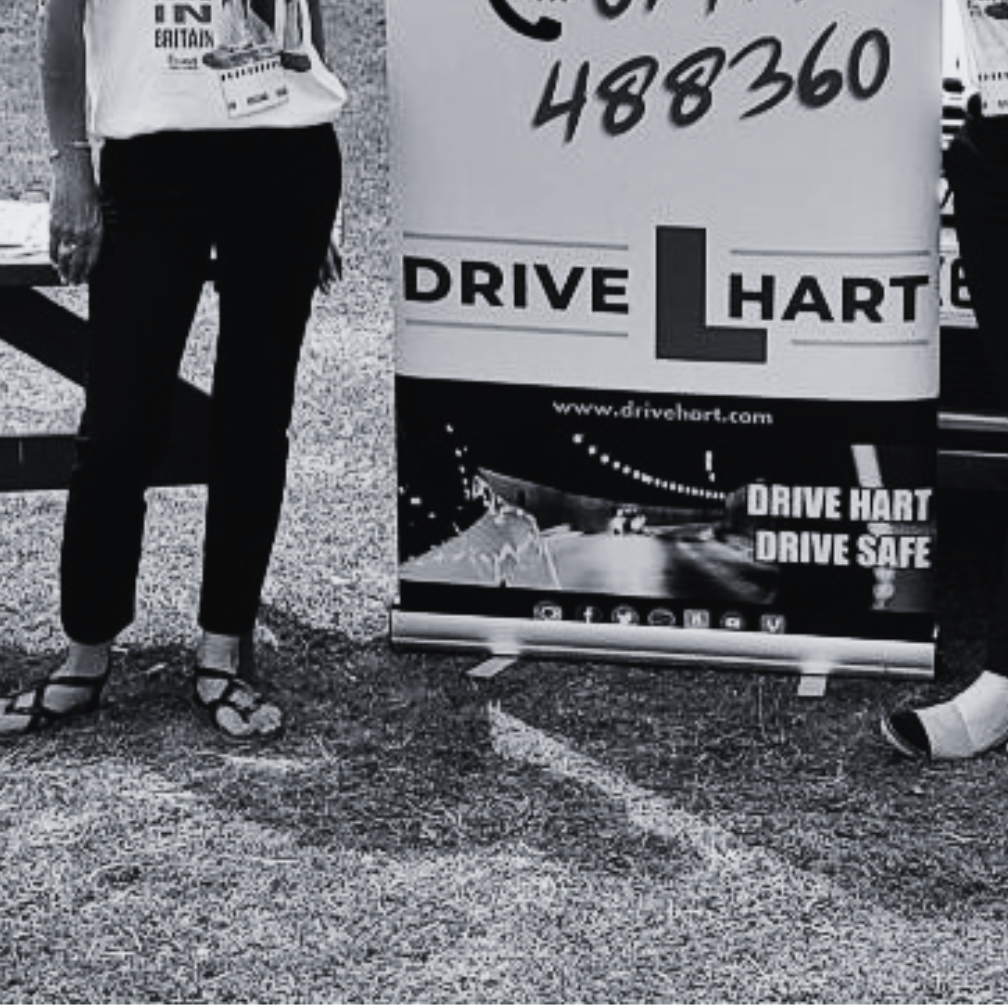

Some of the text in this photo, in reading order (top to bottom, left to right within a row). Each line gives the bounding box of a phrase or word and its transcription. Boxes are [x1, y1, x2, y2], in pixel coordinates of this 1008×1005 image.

[154, 4, 212, 24] IN
[155, 28, 215, 49] BRITAIN
[531, 21, 891, 144] 488360
[402, 255, 629, 315] DRIVE
[654, 224, 768, 365] L
[728, 272, 931, 324] HART
[552, 399, 774, 426] www.drivehart.com
[747, 482, 932, 521] DRIVE HART
[756, 529, 932, 569] DRIVE SAFE
